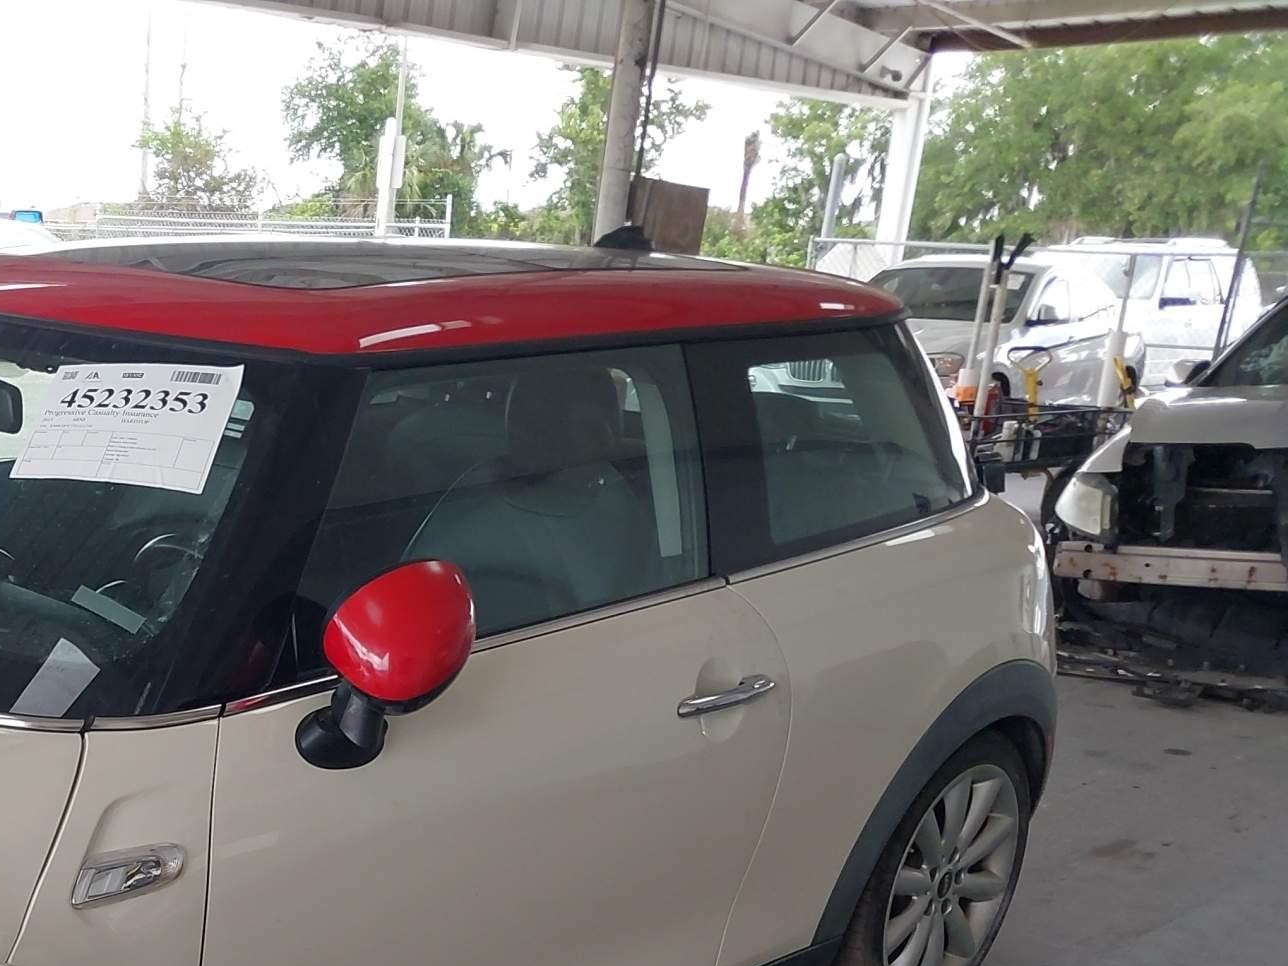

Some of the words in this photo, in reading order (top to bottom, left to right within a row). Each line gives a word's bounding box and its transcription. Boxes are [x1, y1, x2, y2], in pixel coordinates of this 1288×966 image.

[60, 388, 209, 414] 45232353
[44, 409, 86, 418] Progressive
[88, 409, 120, 418] Casualty
[122, 409, 160, 419] Insurance
